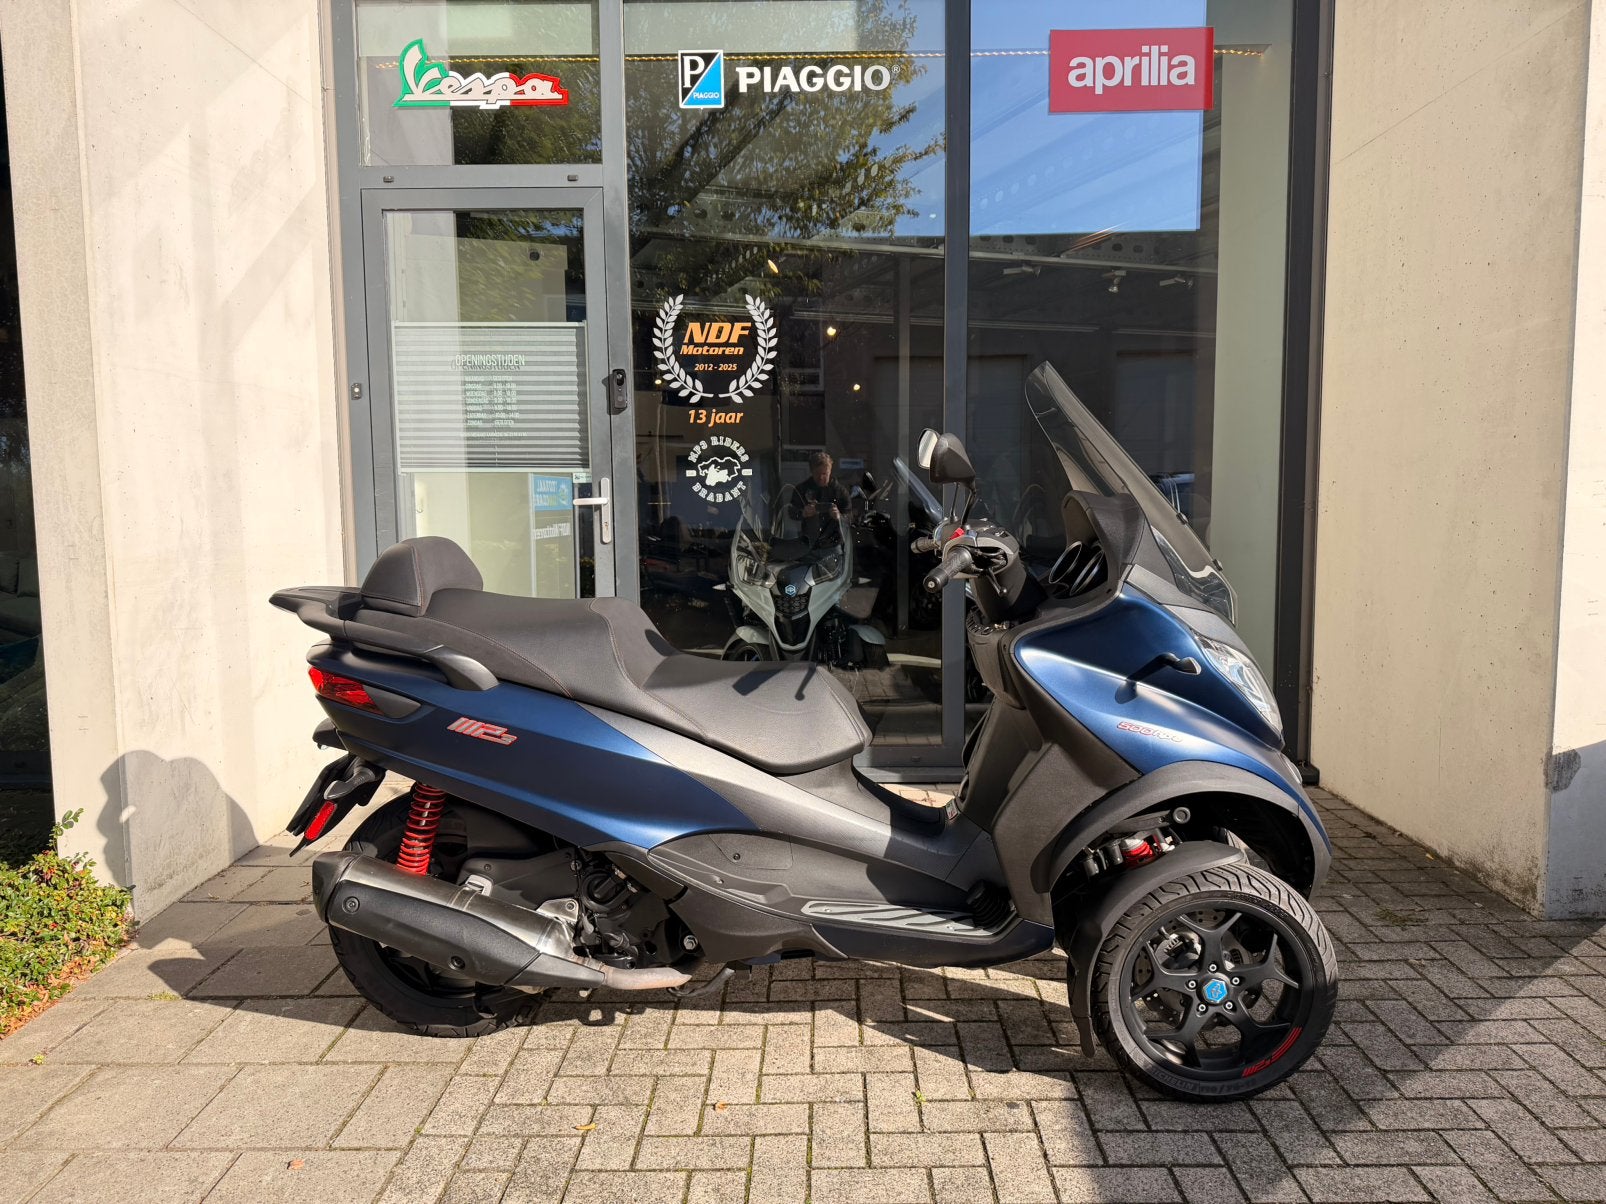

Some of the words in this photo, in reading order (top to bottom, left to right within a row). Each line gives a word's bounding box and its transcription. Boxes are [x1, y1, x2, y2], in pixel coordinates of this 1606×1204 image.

[398, 42, 566, 106] Vespa
[682, 55, 706, 88] P
[735, 64, 891, 93] PIAGGIO
[1067, 45, 1196, 95] aprilia
[693, 91, 720, 100] PIAGGIO
[683, 322, 752, 344] NDF
[680, 344, 745, 355] Motoren
[694, 363, 713, 371] 2012
[718, 363, 738, 371] 2025
[688, 409, 707, 424] 13
[708, 408, 744, 427] jaar
[688, 440, 708, 463] MP3
[710, 436, 750, 463] RIDERS
[691, 480, 747, 503] BRABANT
[446, 716, 518, 747] MP3
